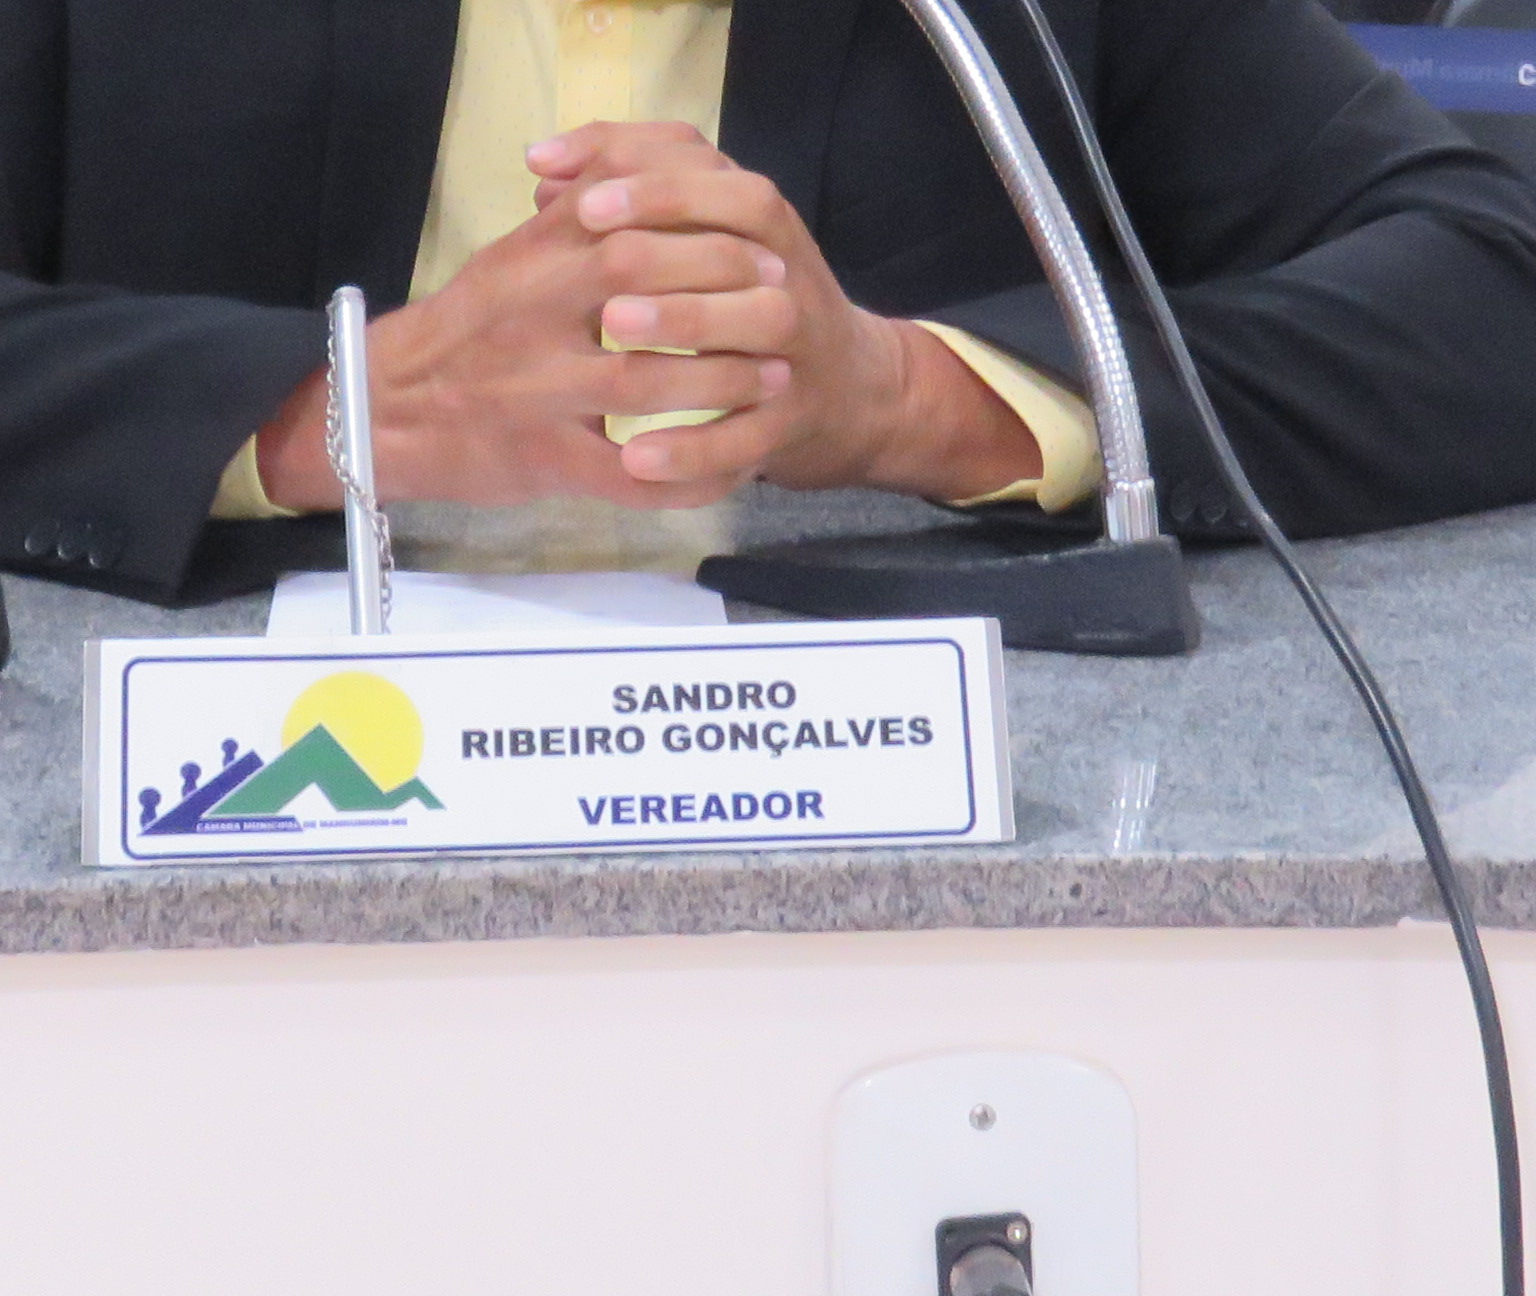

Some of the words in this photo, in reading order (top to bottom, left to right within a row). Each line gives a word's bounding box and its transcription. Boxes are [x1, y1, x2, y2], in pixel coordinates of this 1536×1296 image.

[612, 679, 797, 714] SANDRO
[462, 726, 646, 760] RIBEIRO
[660, 714, 934, 757] GONÇALVES
[577, 789, 824, 826] VEREADOR
